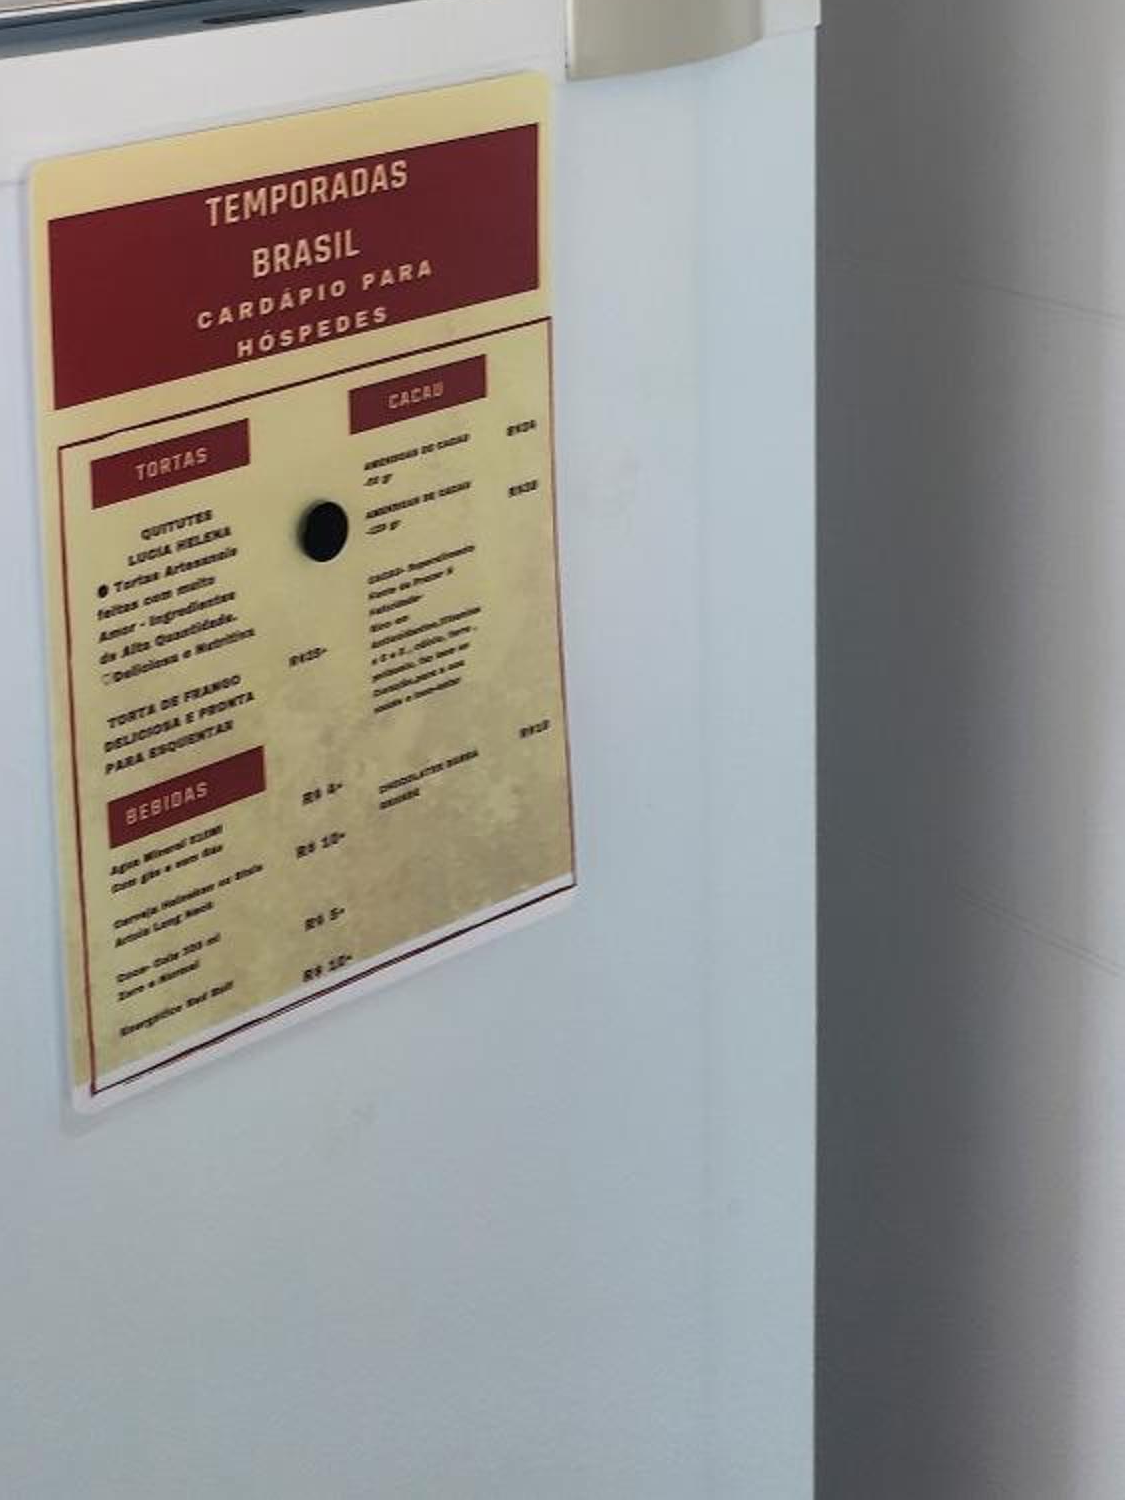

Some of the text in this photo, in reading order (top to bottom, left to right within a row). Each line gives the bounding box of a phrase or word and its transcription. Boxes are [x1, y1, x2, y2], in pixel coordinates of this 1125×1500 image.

[205, 160, 408, 227] TEMPORADAS
[252, 229, 361, 279] BRASIL
[197, 259, 433, 329] CARDÁPIO PARA
[237, 306, 387, 358] HÓSPEDES
[388, 382, 444, 409] CACAU
[135, 447, 208, 481] TORTAS
[141, 509, 213, 541] QUITUTES
[176, 526, 232, 552] HELENA
[113, 547, 238, 593] Tortas Artesanais
[99, 623, 137, 643] Amor
[149, 591, 236, 626] Ingredientes
[99, 651, 117, 665] de
[122, 641, 151, 658] Alta
[104, 691, 255, 753] DELICIOSA E PRONTA
[107, 674, 242, 729] TORTA DE FRANGO
[105, 752, 145, 776] PARA
[125, 782, 209, 825] BEBIDAS
